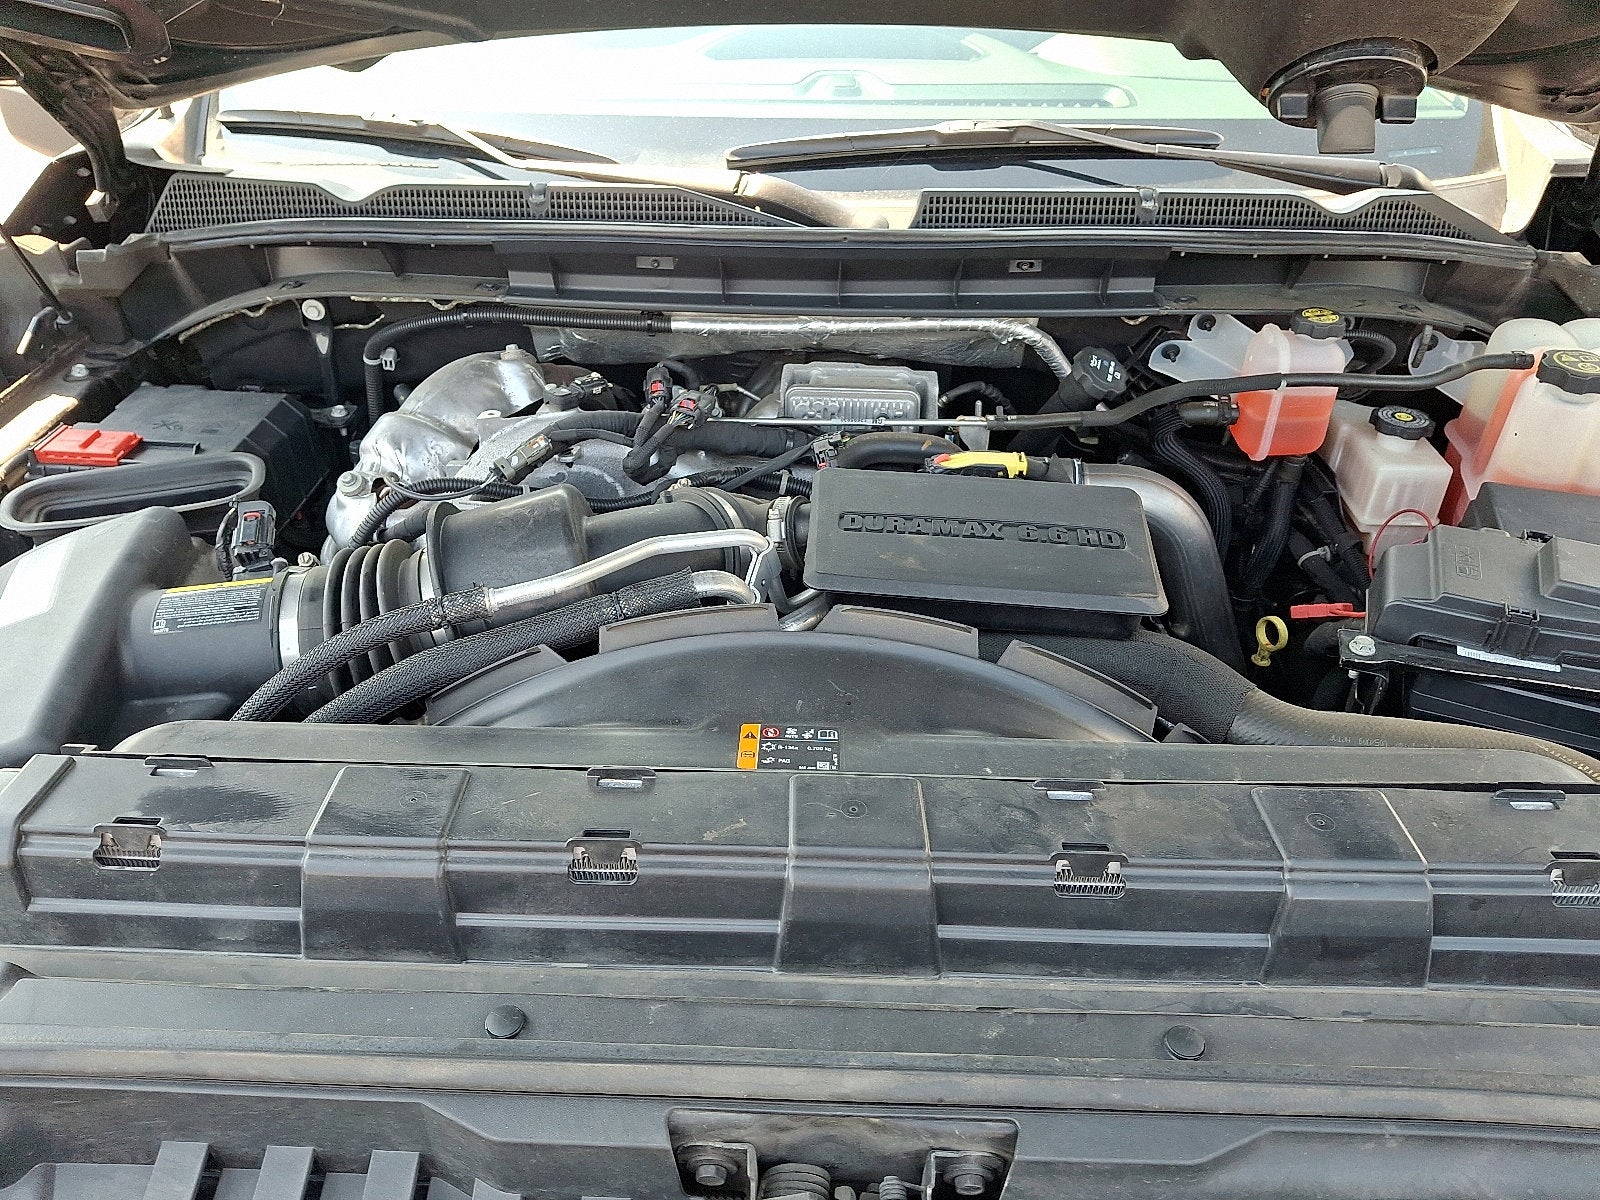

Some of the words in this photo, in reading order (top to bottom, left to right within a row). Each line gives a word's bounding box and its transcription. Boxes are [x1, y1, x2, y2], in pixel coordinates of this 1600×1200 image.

[842, 513, 1005, 540] DURAMAX
[1017, 524, 1069, 544] 6.6
[1076, 528, 1124, 549] HD
